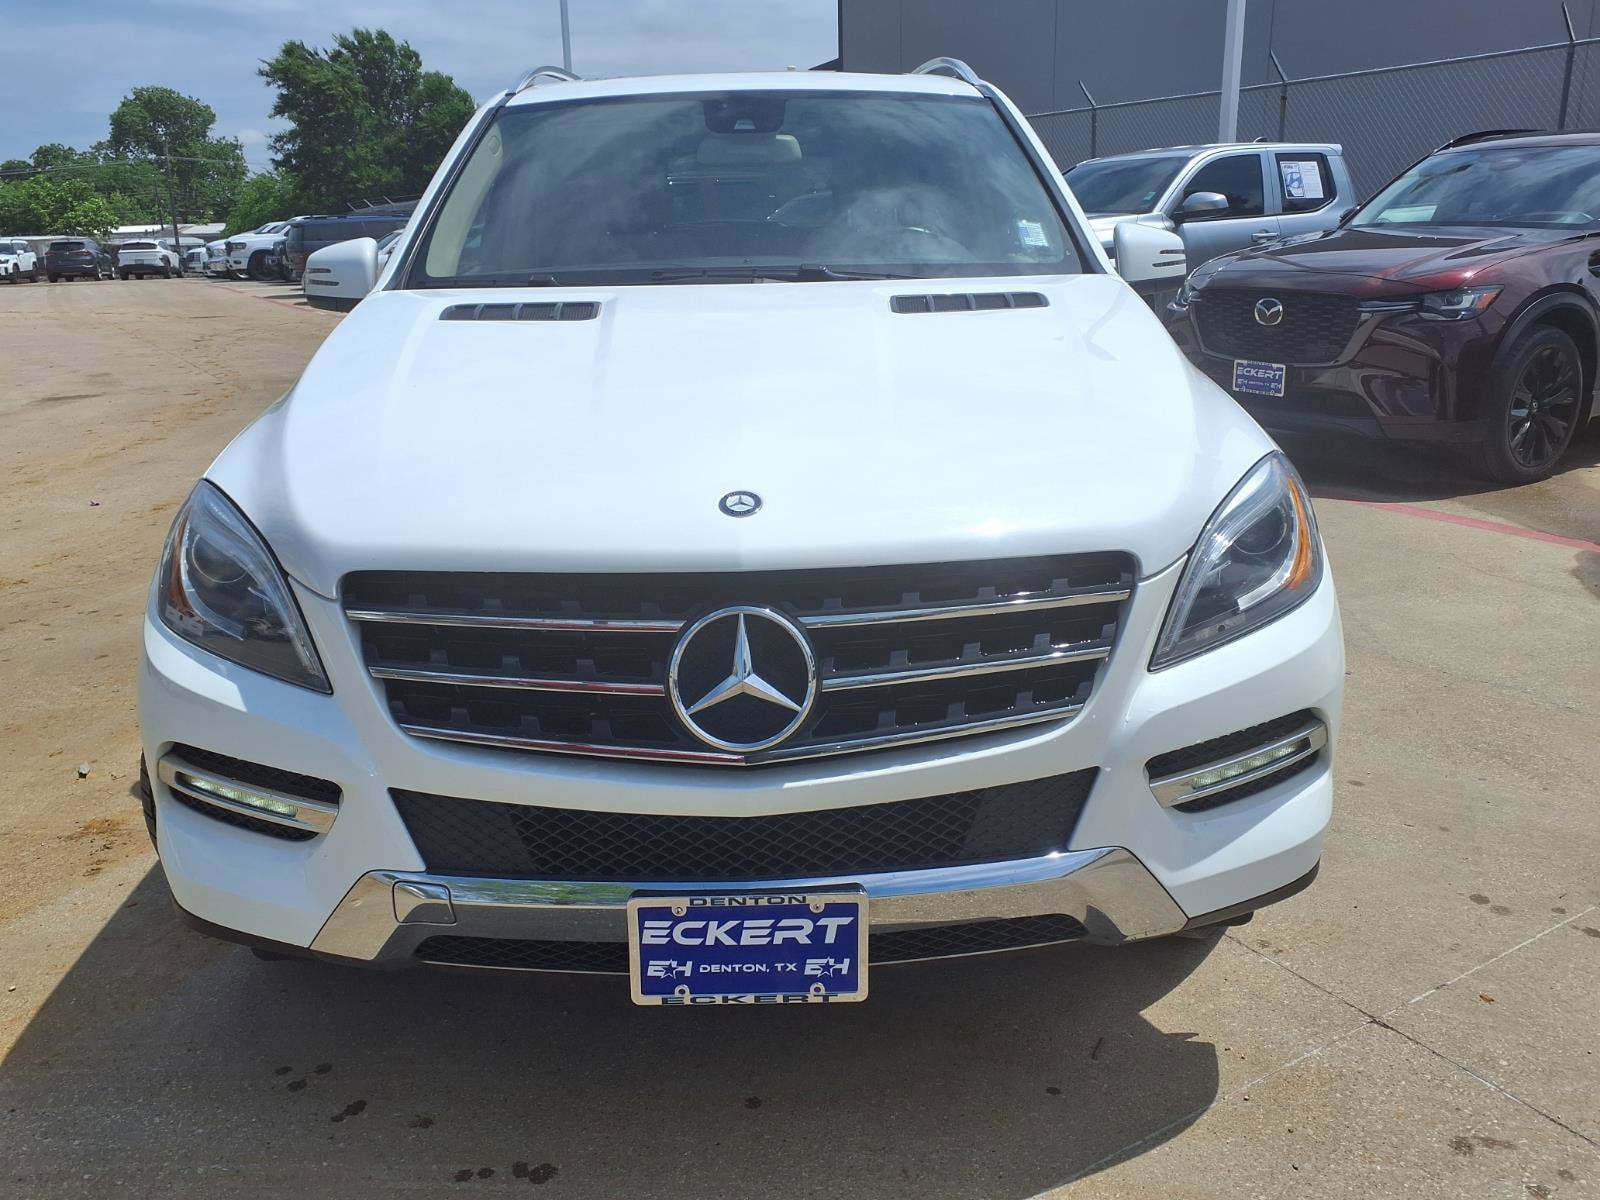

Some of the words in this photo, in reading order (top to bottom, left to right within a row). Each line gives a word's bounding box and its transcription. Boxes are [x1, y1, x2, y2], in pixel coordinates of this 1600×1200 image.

[1237, 367, 1282, 379] ECKERT
[690, 895, 807, 906] DENTON
[642, 917, 854, 945] ECKERT
[700, 964, 769, 974] DENTON,
[775, 963, 797, 972] TX
[661, 993, 838, 1004] ECKERT
